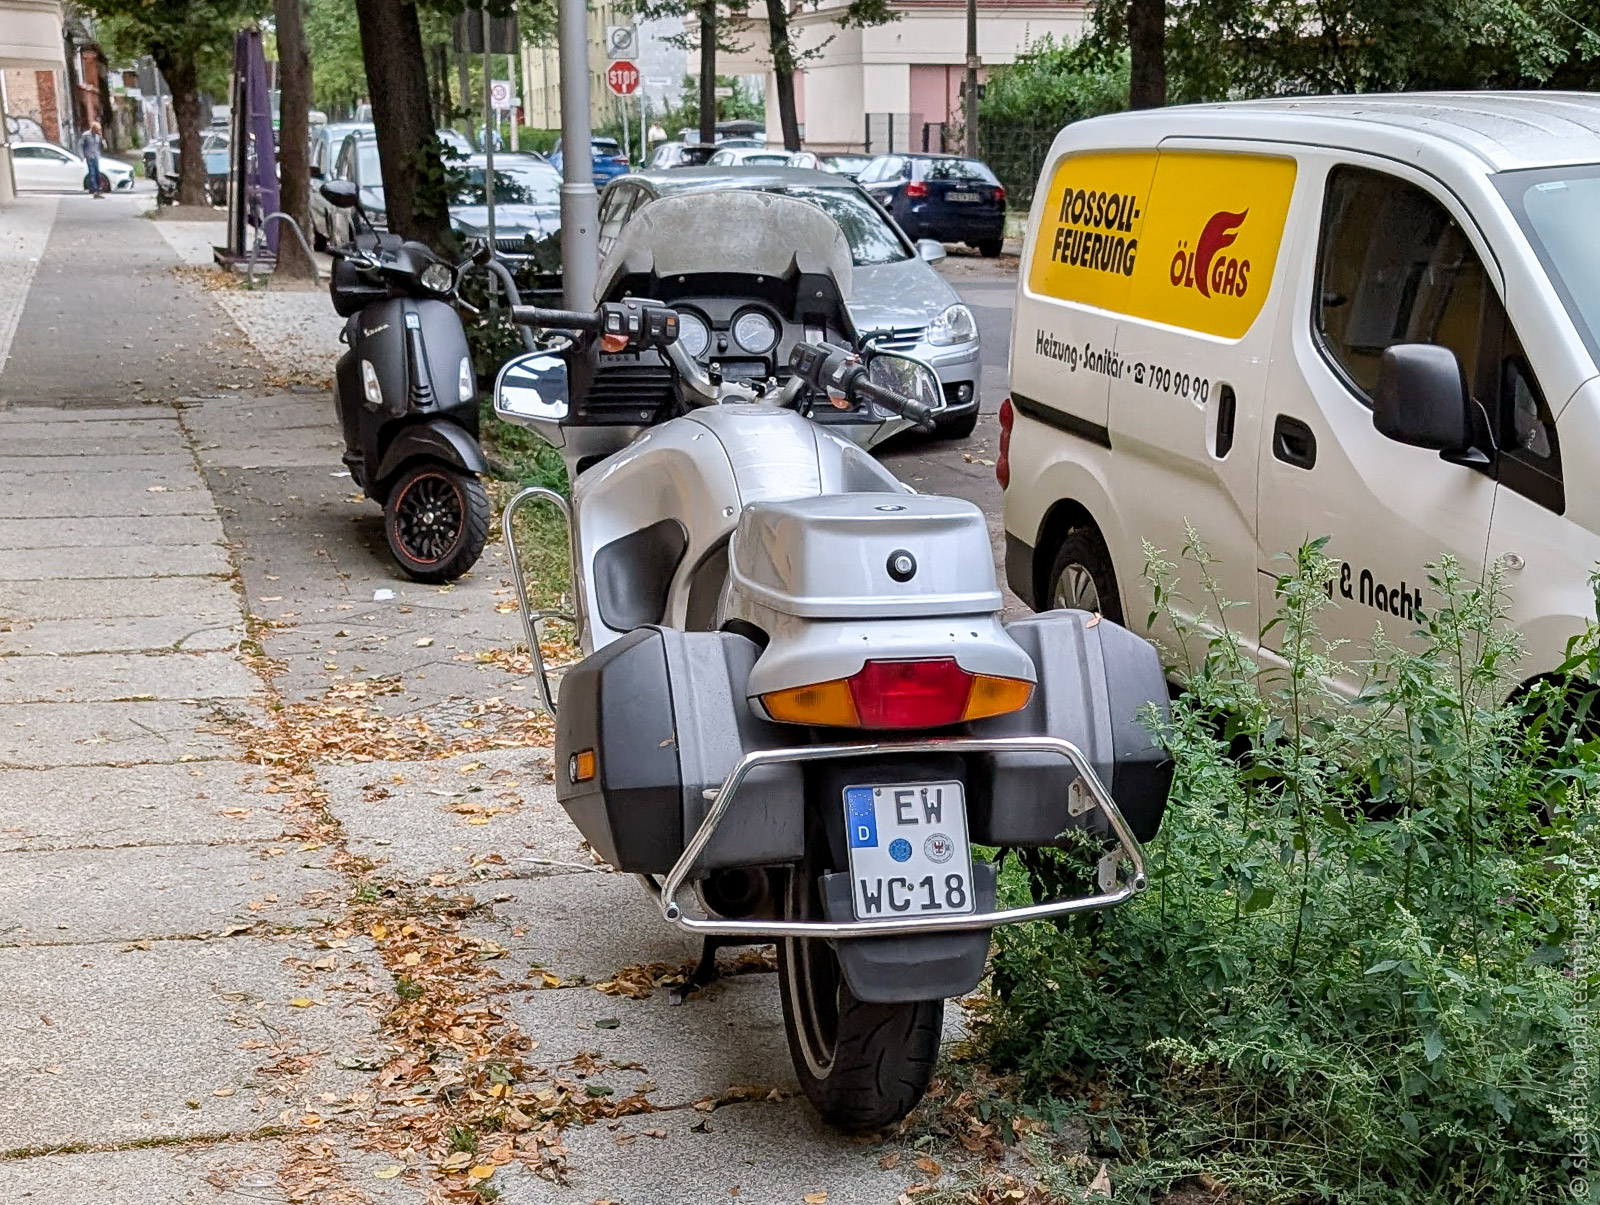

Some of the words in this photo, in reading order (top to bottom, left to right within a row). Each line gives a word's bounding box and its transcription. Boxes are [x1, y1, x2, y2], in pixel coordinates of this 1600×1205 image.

[609, 70, 638, 85] STOP
[1058, 187, 1140, 233] ROSSOLL-
[1052, 227, 1138, 277] FEUERUNG
[1169, 240, 1195, 288] ÖL
[1211, 256, 1250, 298] GAS
[1149, 365, 1171, 393] 790
[1174, 373, 1190, 398] 90
[1192, 378, 1210, 403] 90
[1339, 562, 1354, 600] &
[1359, 568, 1422, 625] Nacht
[894, 788, 942, 825] EW
[858, 825, 870, 841] D
[860, 877, 911, 914] WC
[919, 873, 966, 910] 18
